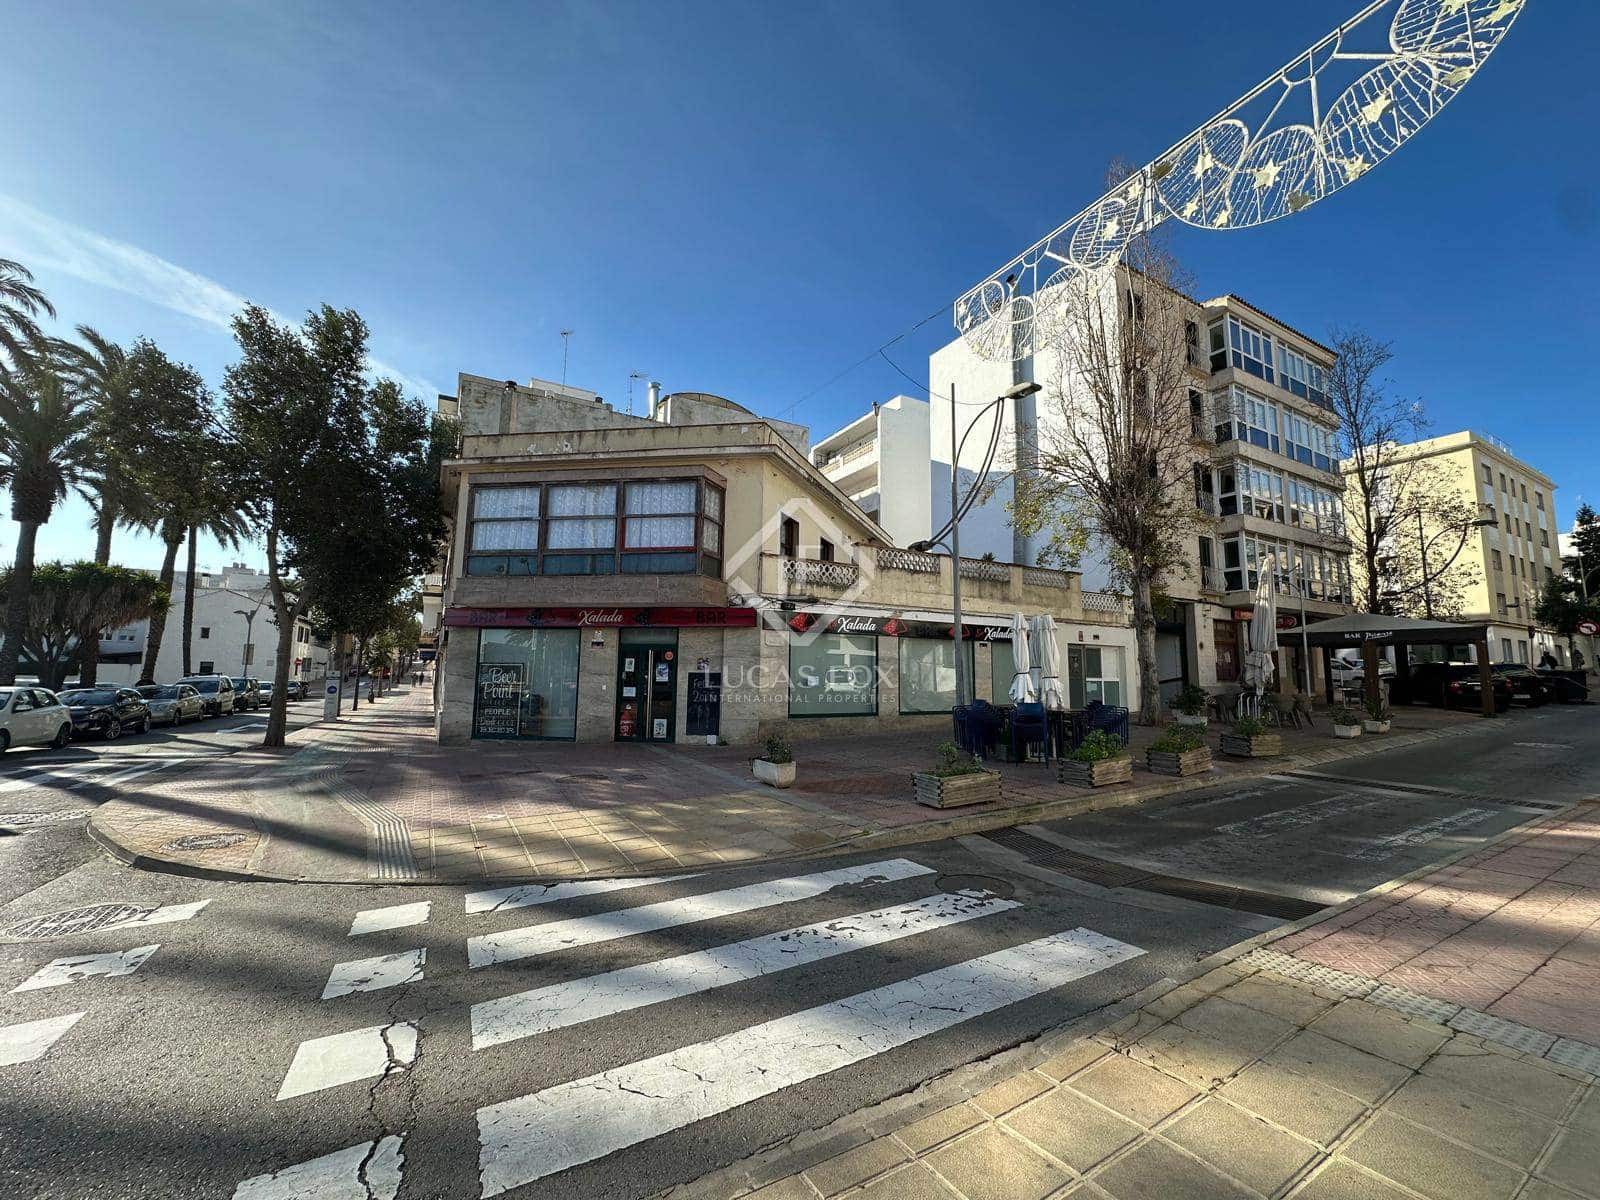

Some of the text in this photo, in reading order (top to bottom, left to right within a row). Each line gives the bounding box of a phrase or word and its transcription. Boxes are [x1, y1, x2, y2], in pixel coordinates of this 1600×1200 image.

[469, 610, 497, 624] BAR
[578, 609, 624, 626] Xalada
[696, 610, 727, 624] BAR
[837, 617, 877, 633] Xalada
[480, 682, 513, 700] Point
